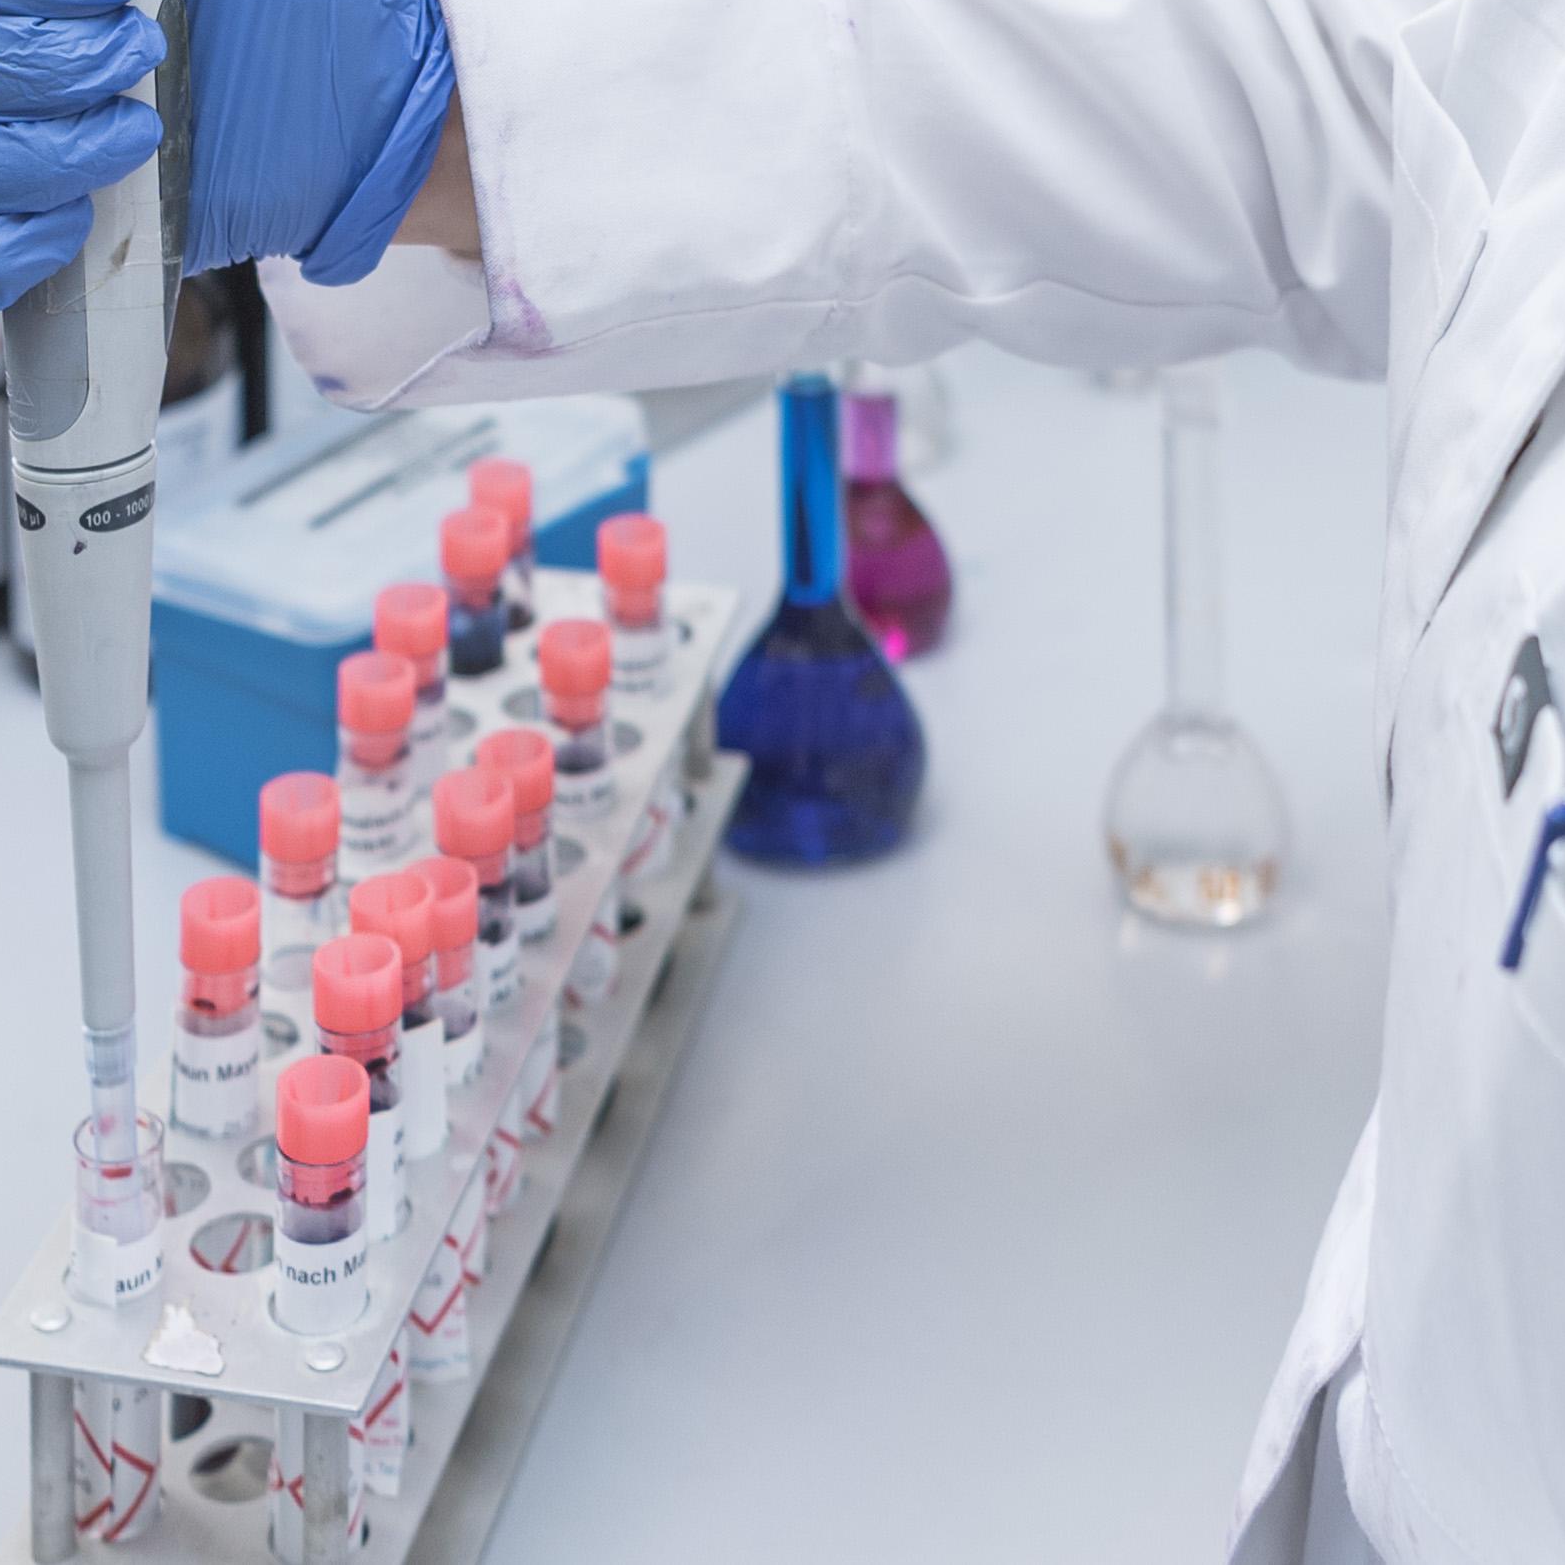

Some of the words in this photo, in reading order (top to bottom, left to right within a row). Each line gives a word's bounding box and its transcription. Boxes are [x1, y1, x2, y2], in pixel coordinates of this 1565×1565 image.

[85, 510, 112, 528] 100
[126, 494, 150, 517] 1000
[286, 1265, 336, 1286] nach
